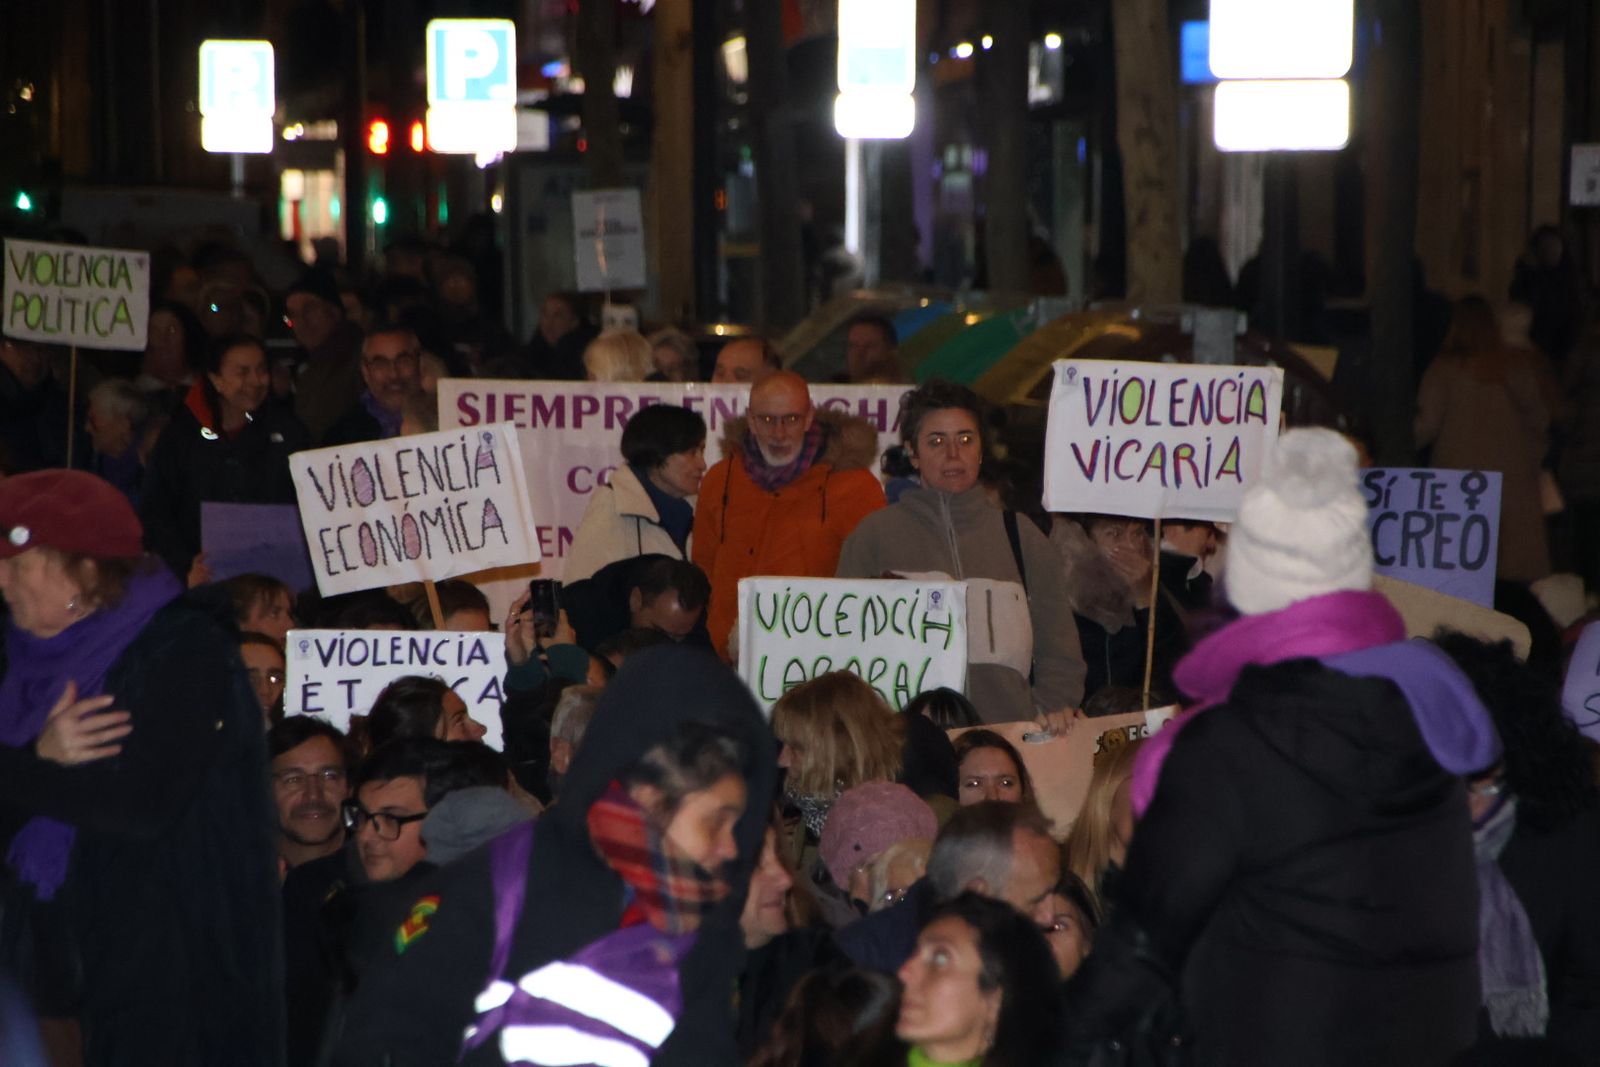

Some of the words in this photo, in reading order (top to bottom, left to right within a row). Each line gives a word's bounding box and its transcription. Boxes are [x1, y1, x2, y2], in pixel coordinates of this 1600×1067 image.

[444, 28, 499, 99] P
[1409, 471, 1448, 510] TE
[1371, 510, 1491, 571] CREO
